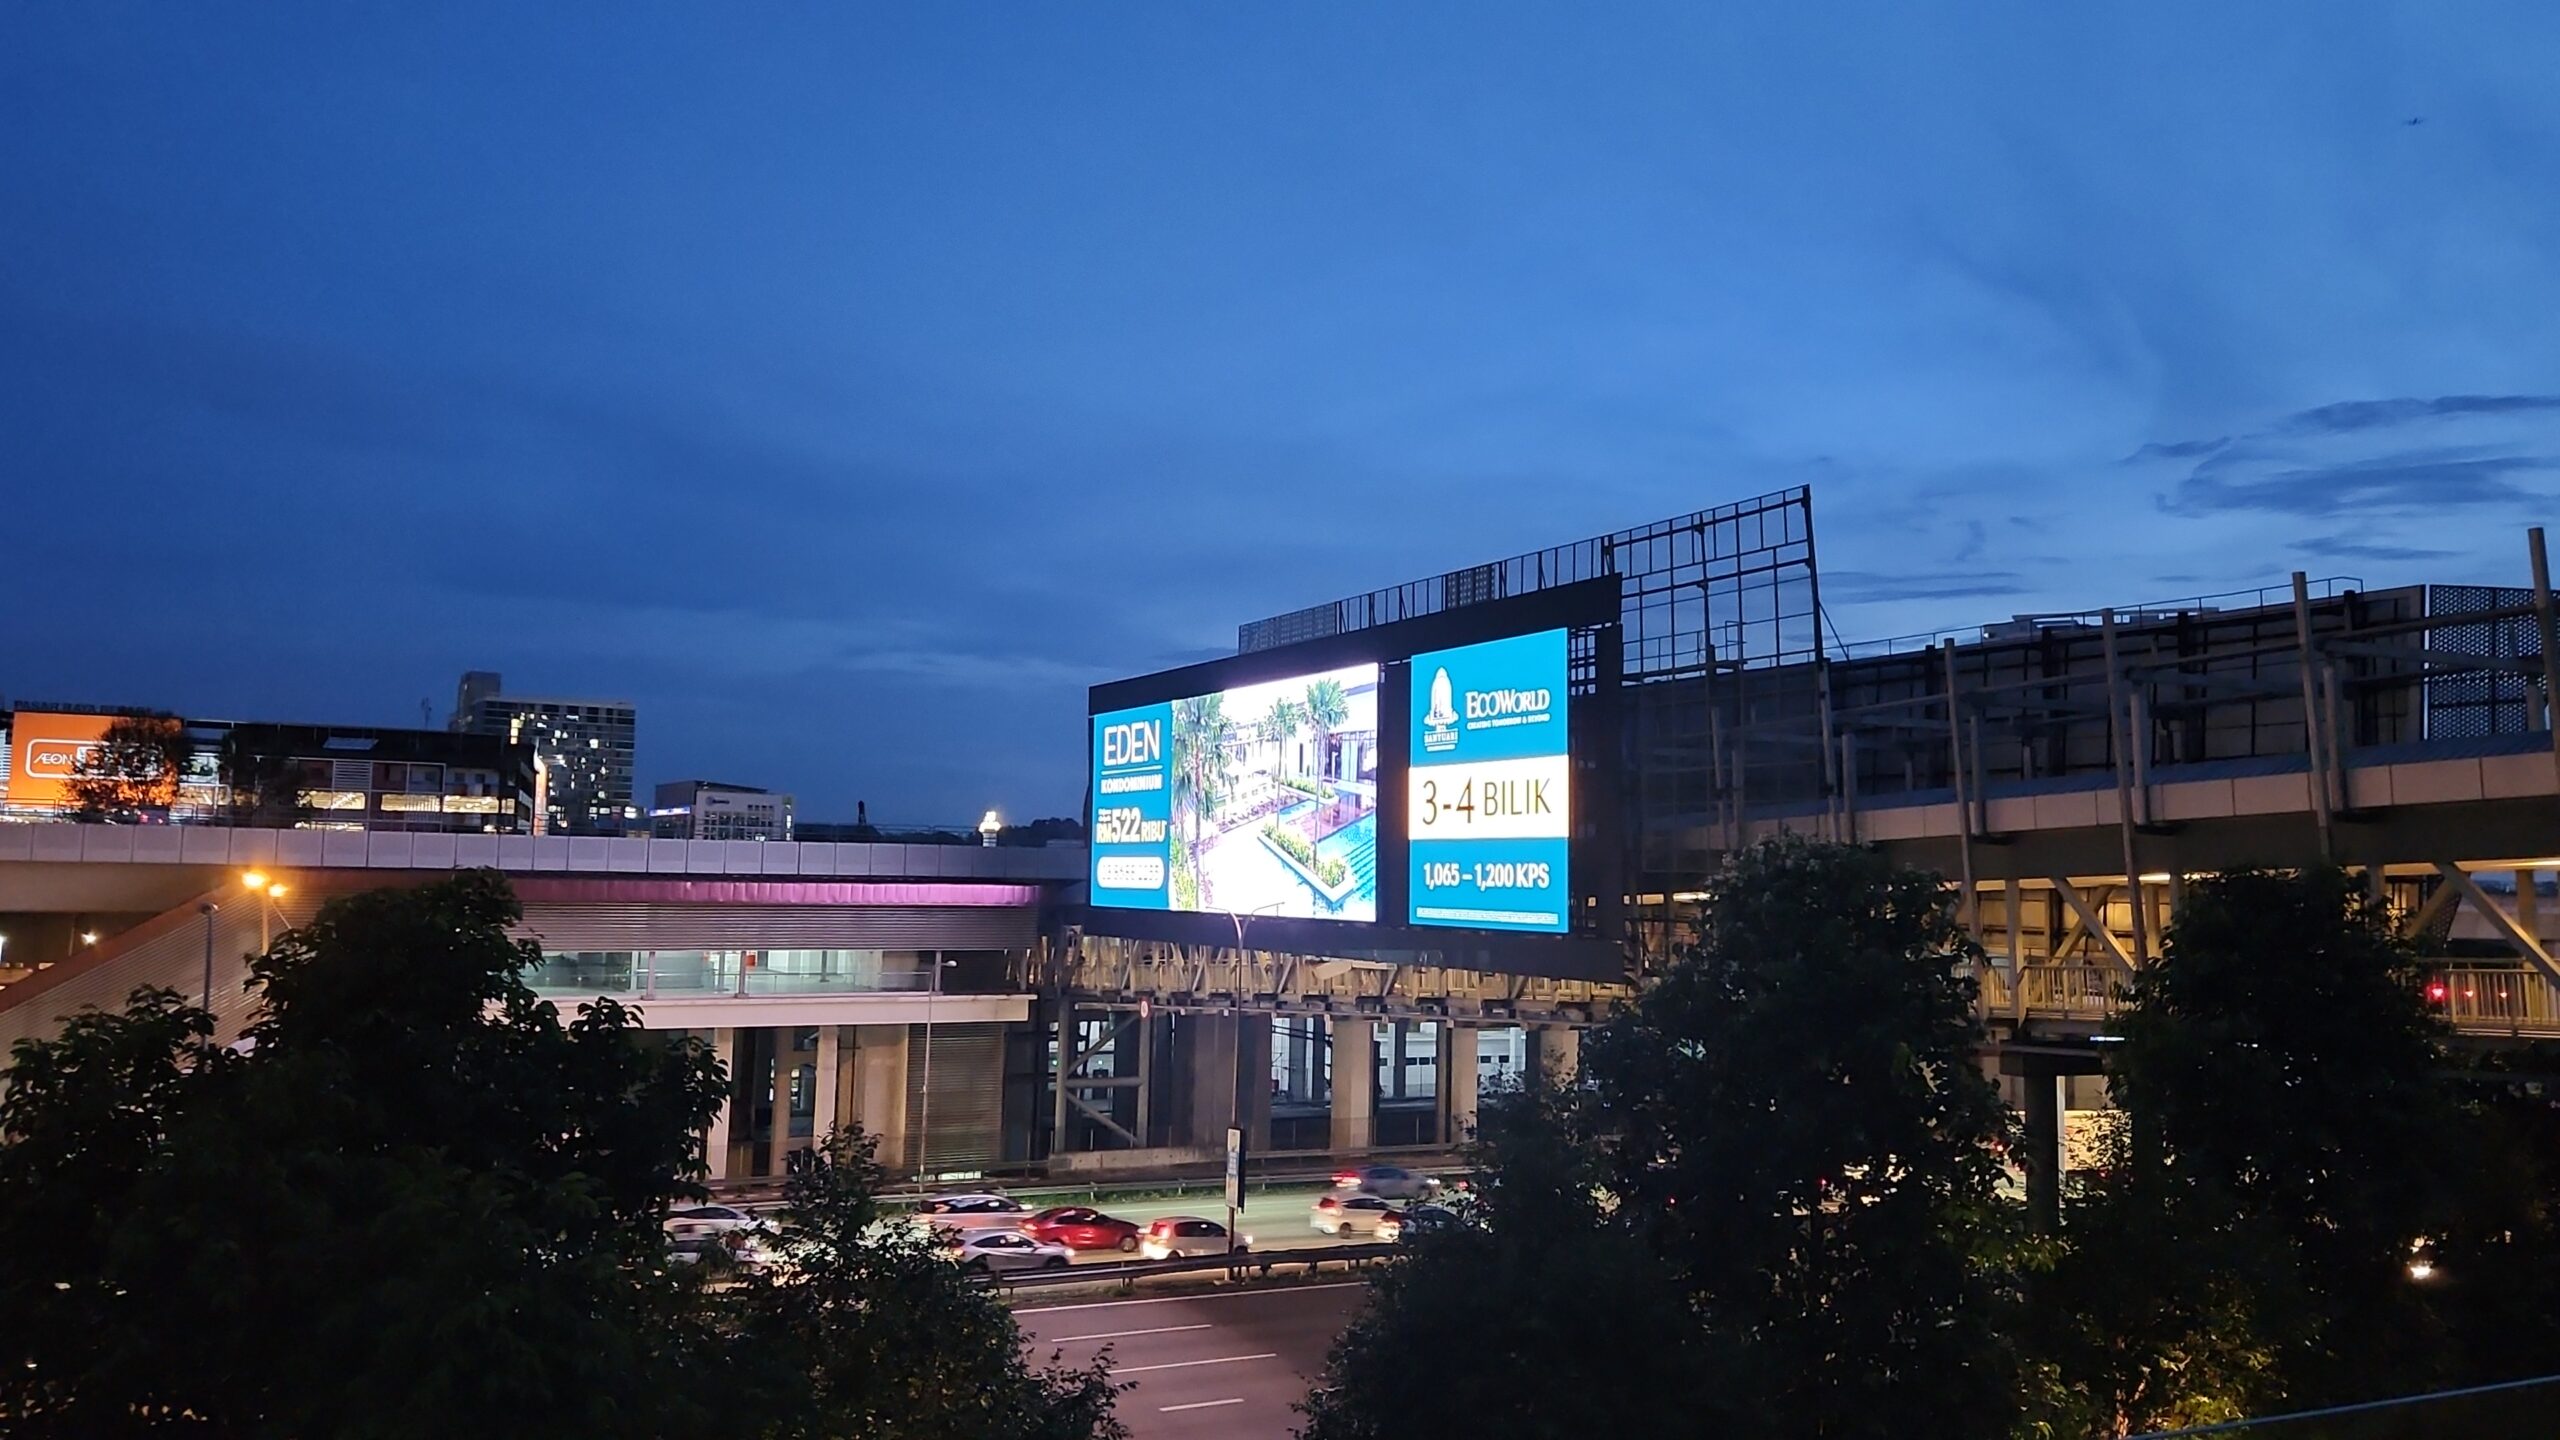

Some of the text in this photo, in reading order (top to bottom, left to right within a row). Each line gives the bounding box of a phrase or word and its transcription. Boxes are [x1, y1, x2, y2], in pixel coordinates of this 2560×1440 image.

[1104, 719, 1160, 766] EDEN
[1101, 774, 1162, 794] KONDOMINIUM
[1422, 775, 1551, 825] 3-4 BILIK
[1423, 862, 1460, 890] 1,065
[1474, 862, 1514, 892] 1,200
[1515, 862, 1550, 889] KPS
